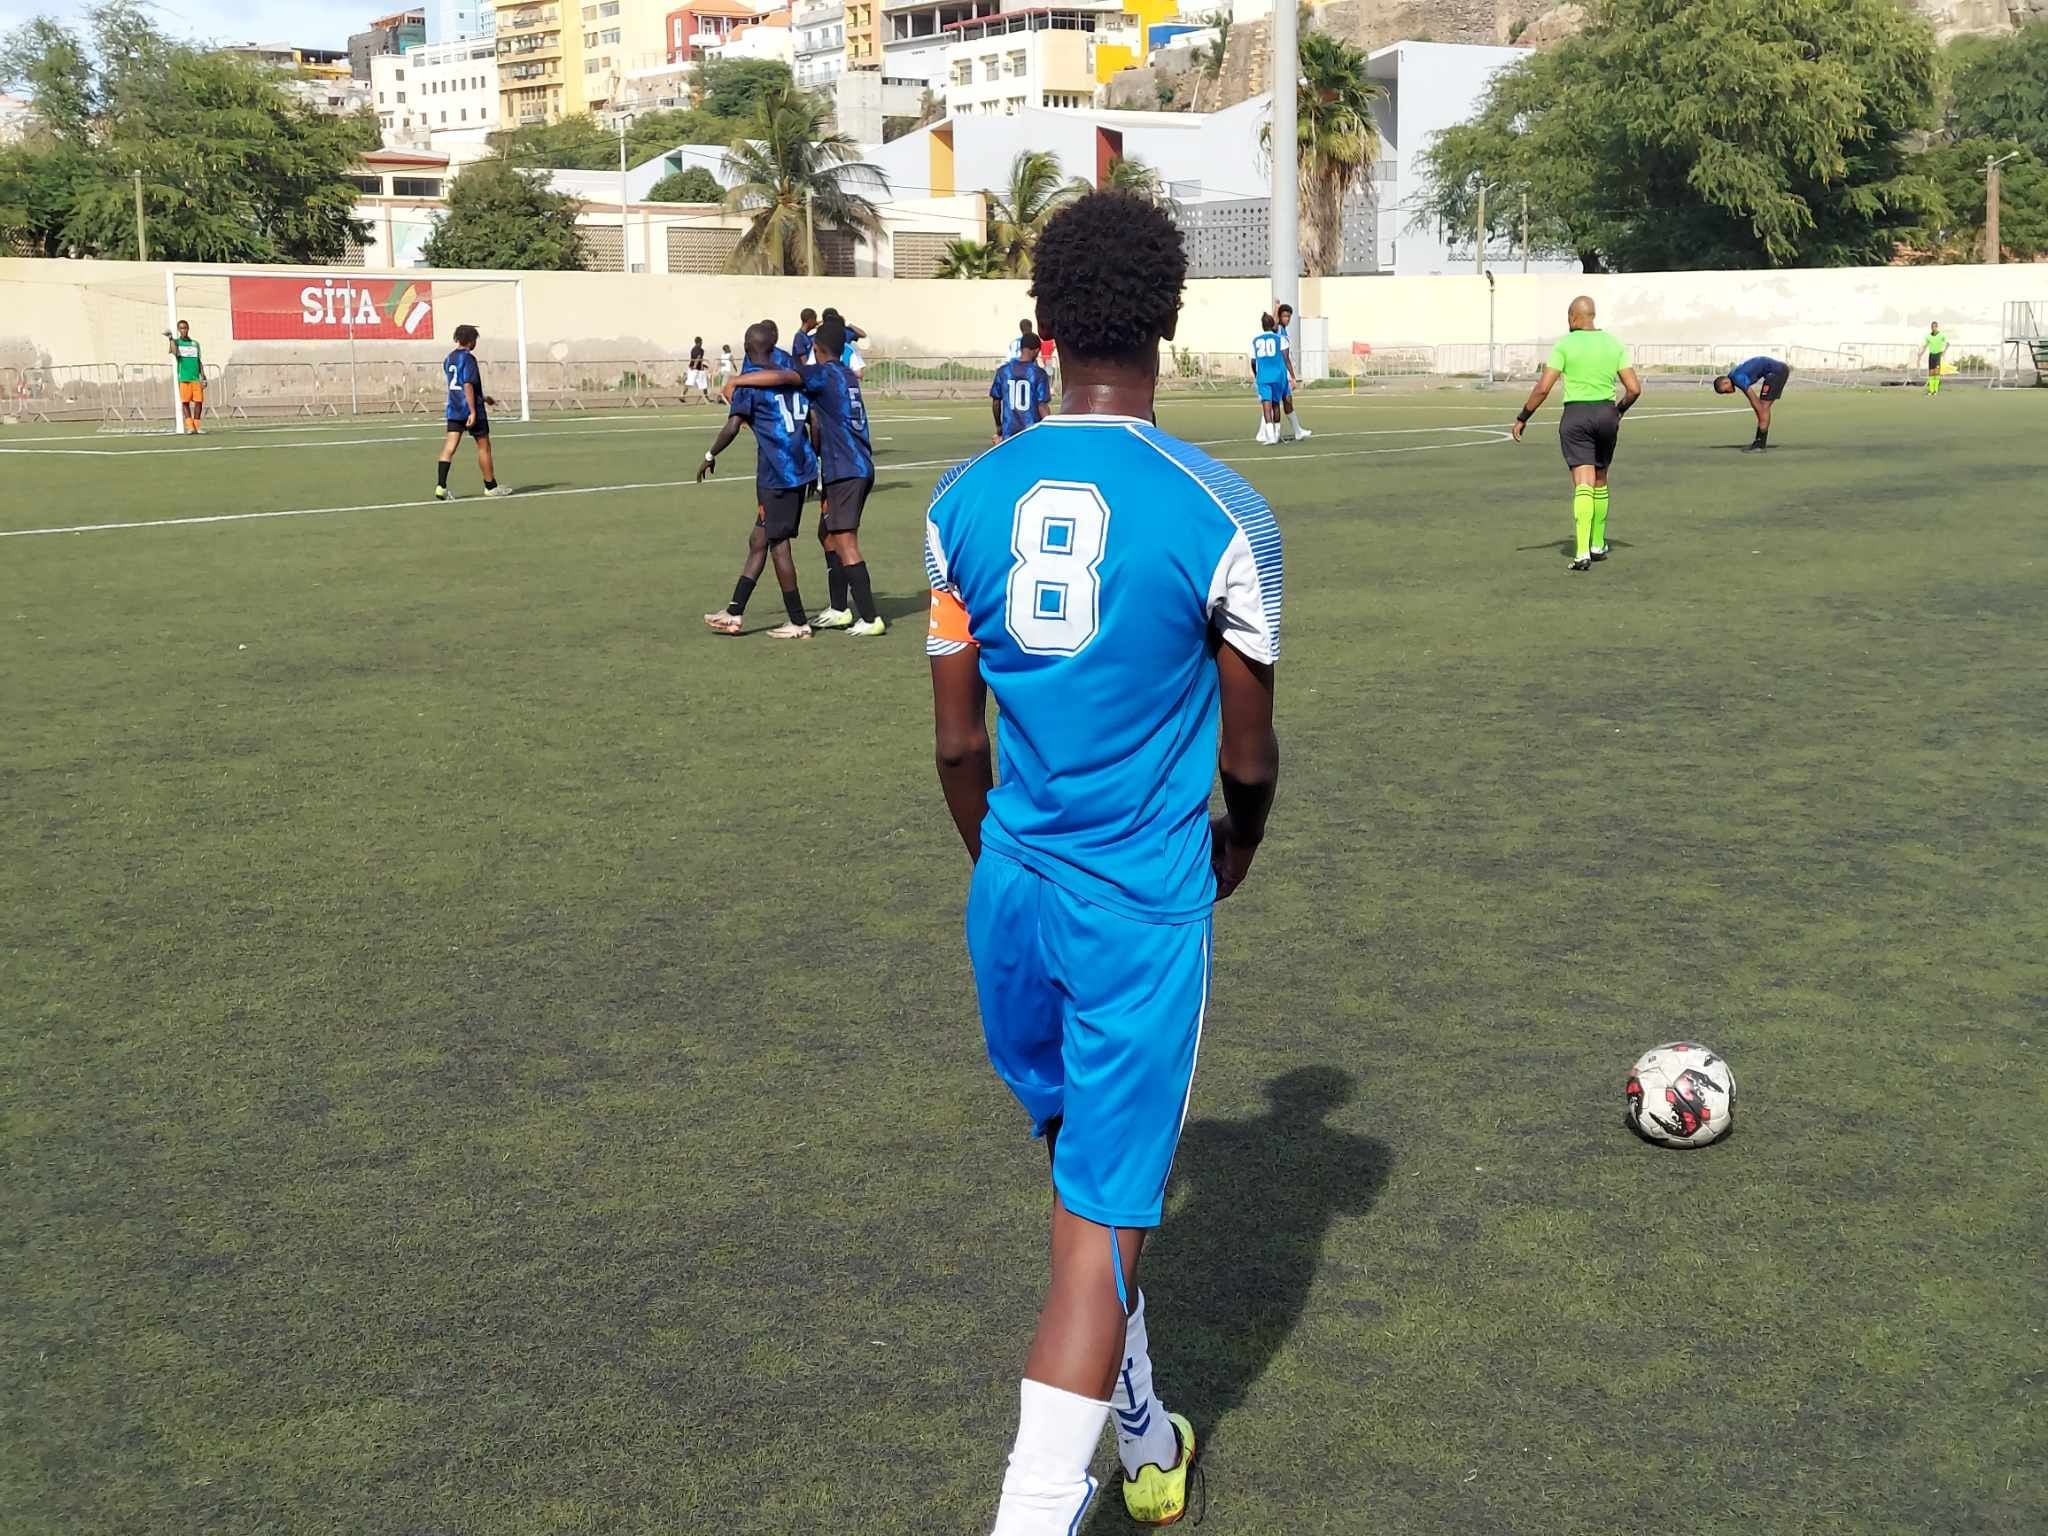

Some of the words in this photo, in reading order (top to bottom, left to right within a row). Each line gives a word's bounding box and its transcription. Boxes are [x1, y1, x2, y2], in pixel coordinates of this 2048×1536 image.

[1255, 338, 1276, 357] 20
[448, 364, 463, 390] 2
[847, 387, 866, 431] 5
[1007, 379, 1031, 411] 10
[1005, 479, 1111, 658] 8
